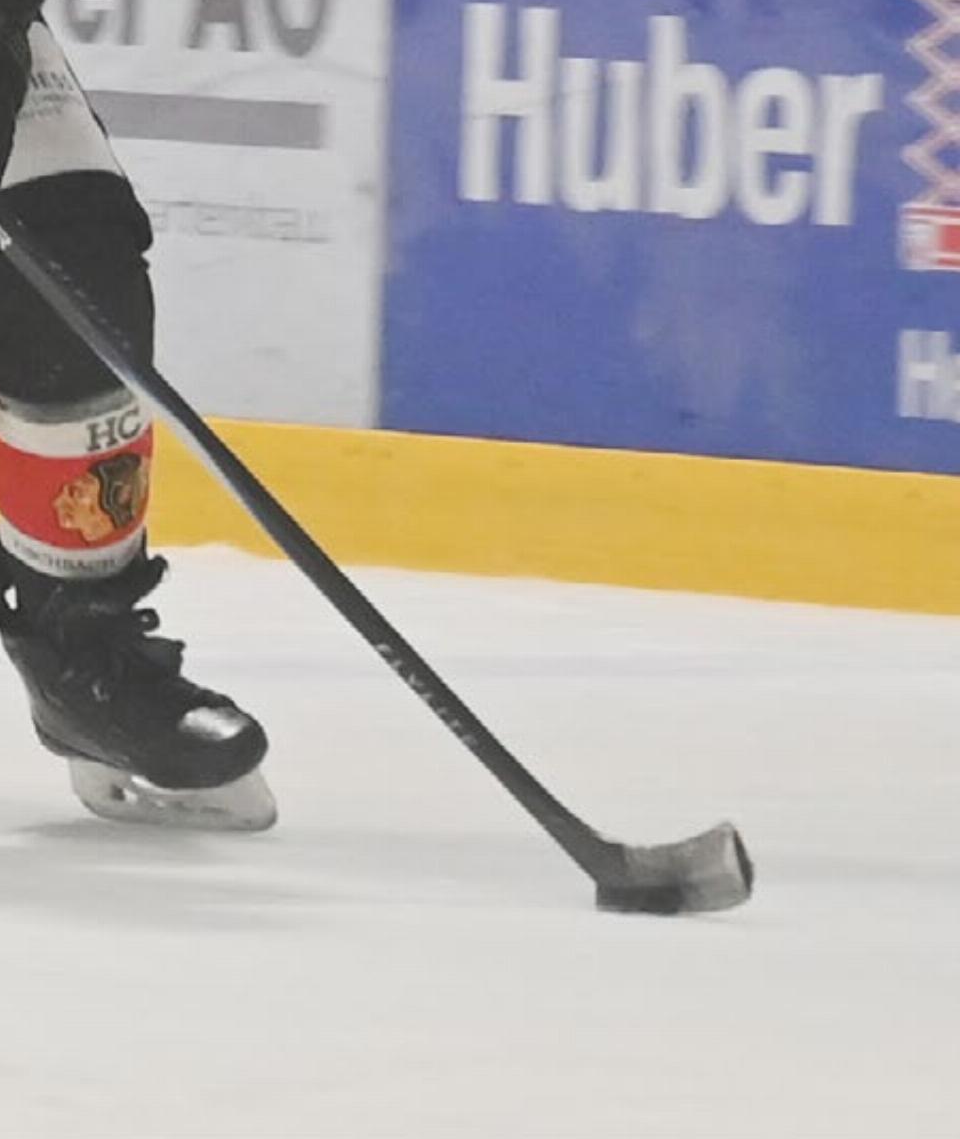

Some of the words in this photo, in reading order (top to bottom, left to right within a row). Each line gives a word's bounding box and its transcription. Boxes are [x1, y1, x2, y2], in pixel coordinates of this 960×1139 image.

[457, 2, 886, 227] Huber
[897, 330, 960, 423] H
[86, 405, 142, 452] HC
